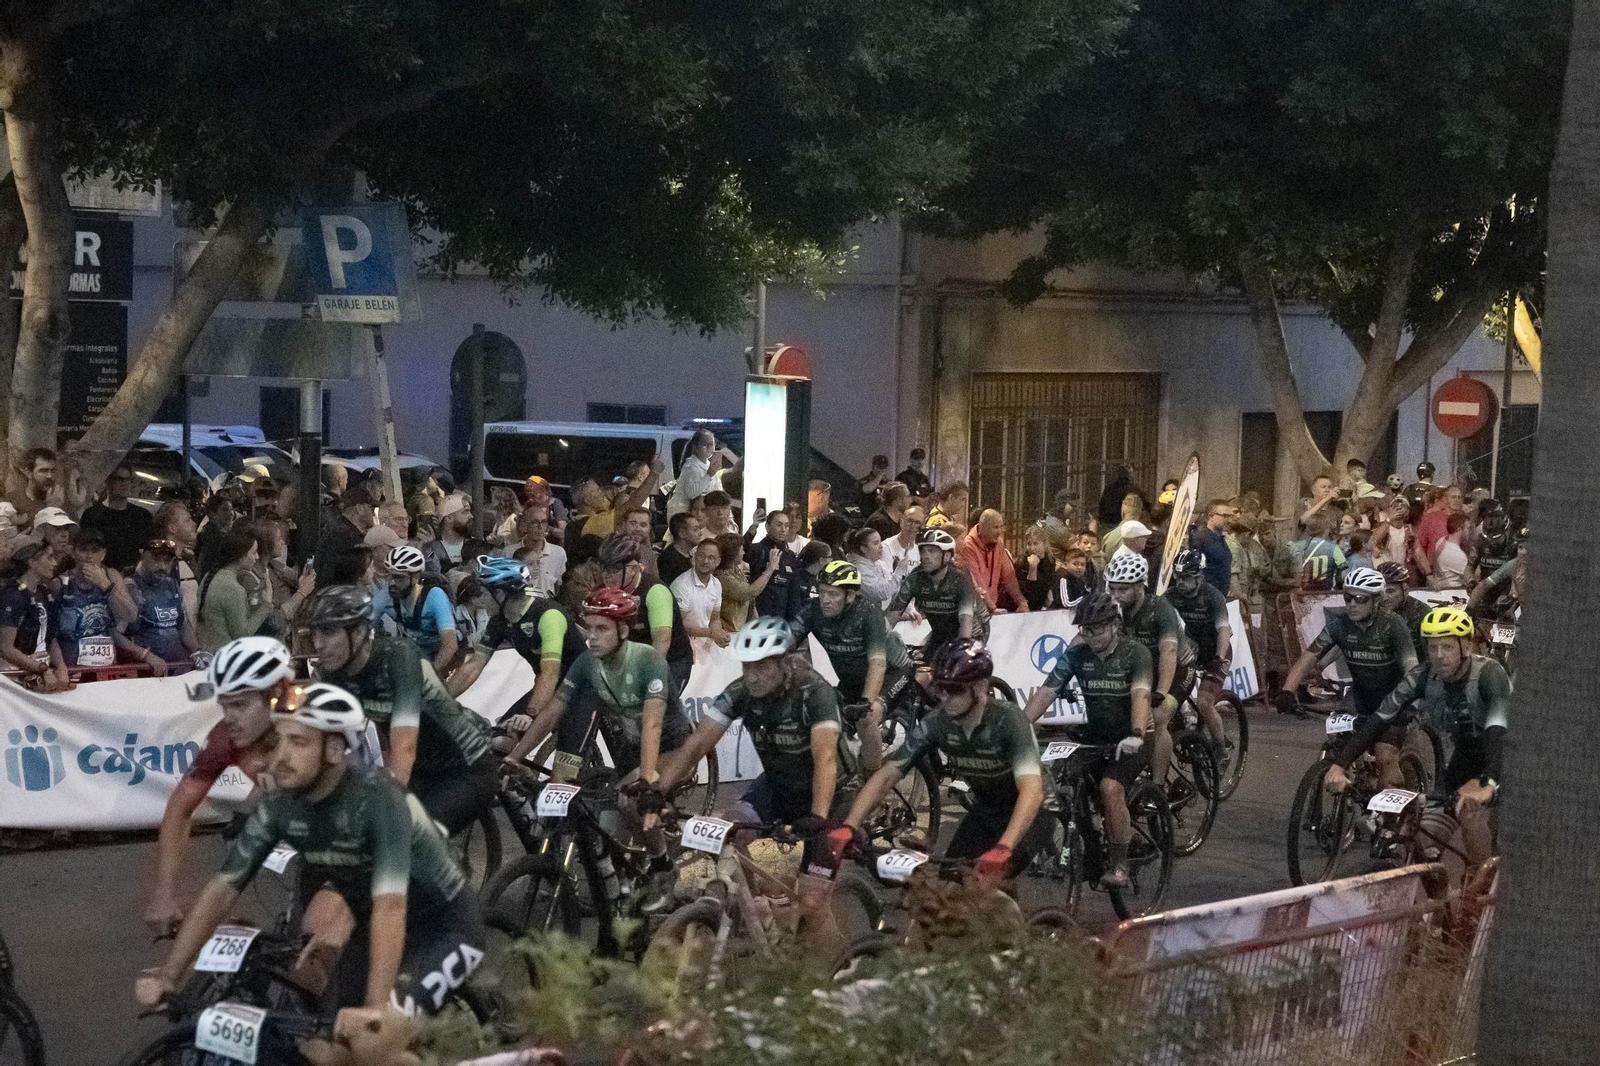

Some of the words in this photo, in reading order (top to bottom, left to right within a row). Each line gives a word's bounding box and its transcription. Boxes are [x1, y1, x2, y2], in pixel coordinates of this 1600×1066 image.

[75, 231, 102, 266] R
[320, 214, 372, 288] P
[324, 298, 361, 310] GARAJE
[365, 298, 395, 311] BELÉN
[90, 645, 110, 656] 3433
[77, 733, 201, 786] cajam
[213, 772, 247, 787] URAL
[544, 791, 572, 804] 6759
[1380, 794, 1409, 805] 7583
[692, 821, 725, 840] 6622
[210, 937, 248, 956] 7268
[209, 1015, 255, 1047] 5699
